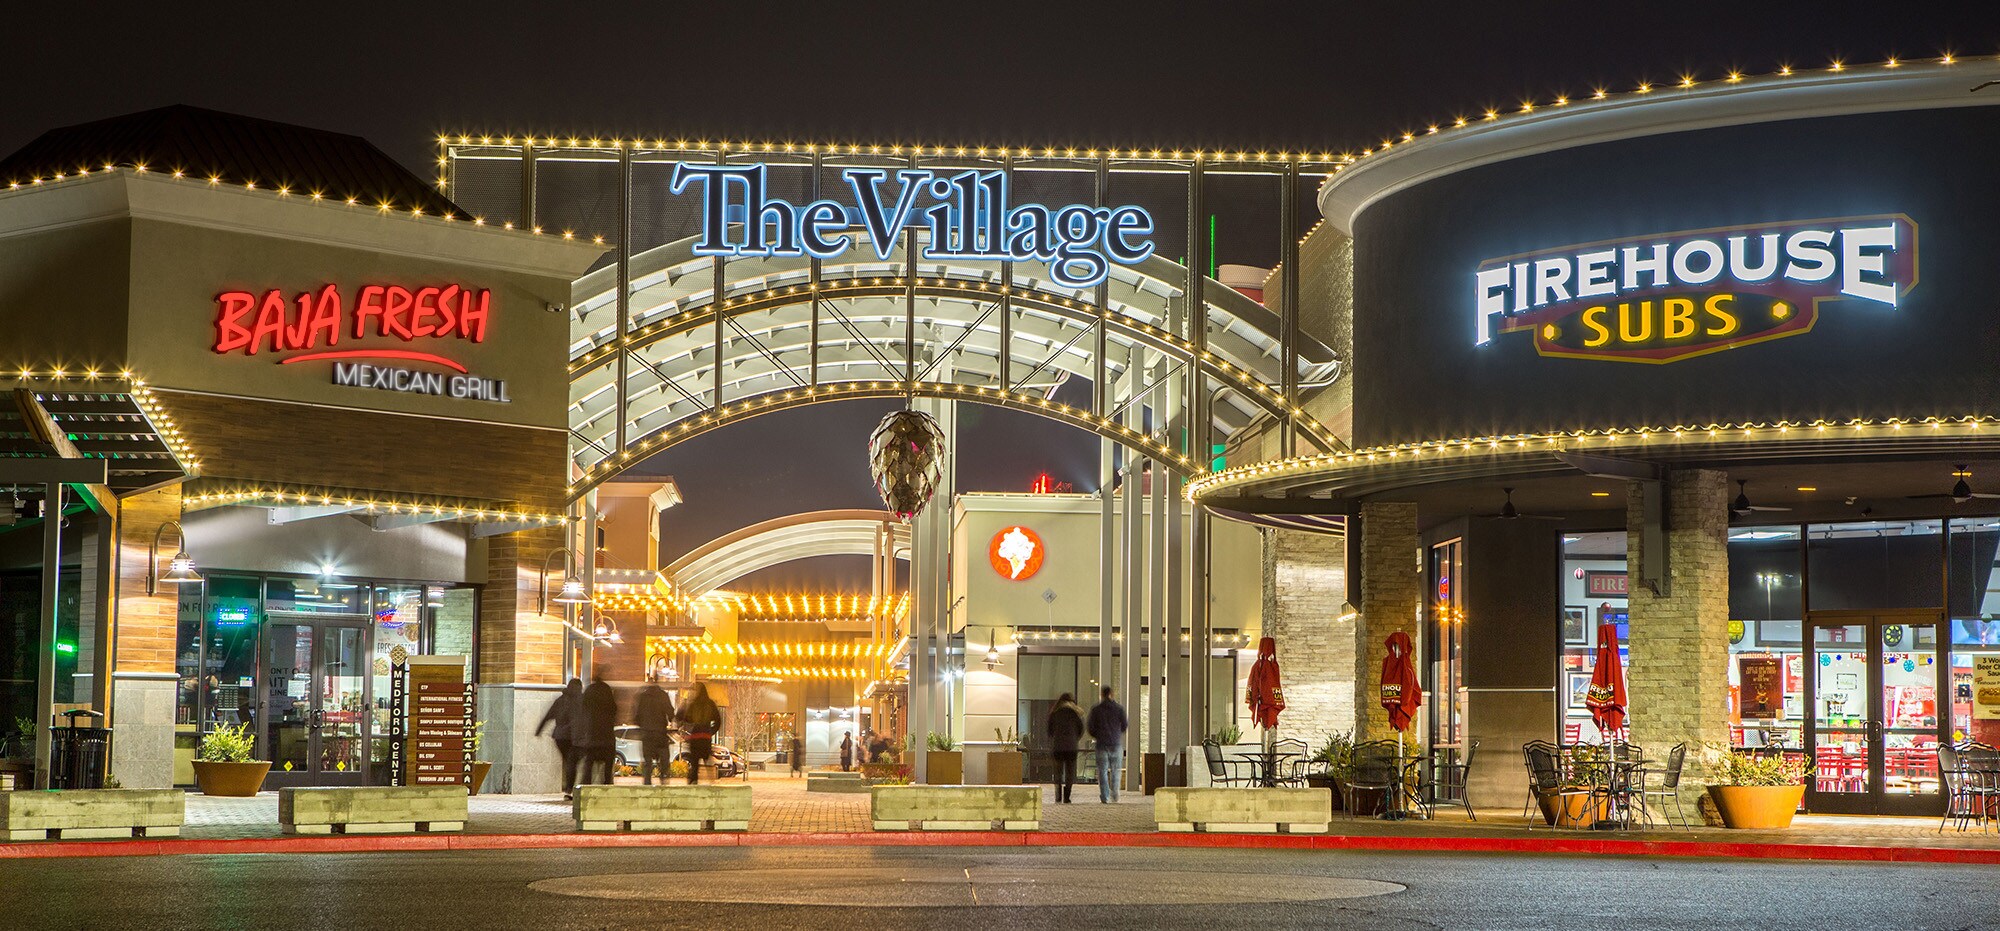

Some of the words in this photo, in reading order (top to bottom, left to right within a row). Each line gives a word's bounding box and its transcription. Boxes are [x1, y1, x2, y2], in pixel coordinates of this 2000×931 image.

[670, 160, 852, 260] The
[843, 167, 1156, 288] Village
[1474, 222, 1898, 347] FIREHOUSE
[211, 283, 342, 356] BAJA
[351, 283, 491, 344] FRESH
[1582, 294, 1738, 348] SUBS
[332, 361, 442, 396] MEXICAN
[447, 374, 512, 403] GRILL
[1593, 578, 1626, 591] FIRE
[393, 670, 402, 735] MEDFORD
[391, 741, 401, 786] CENTE
